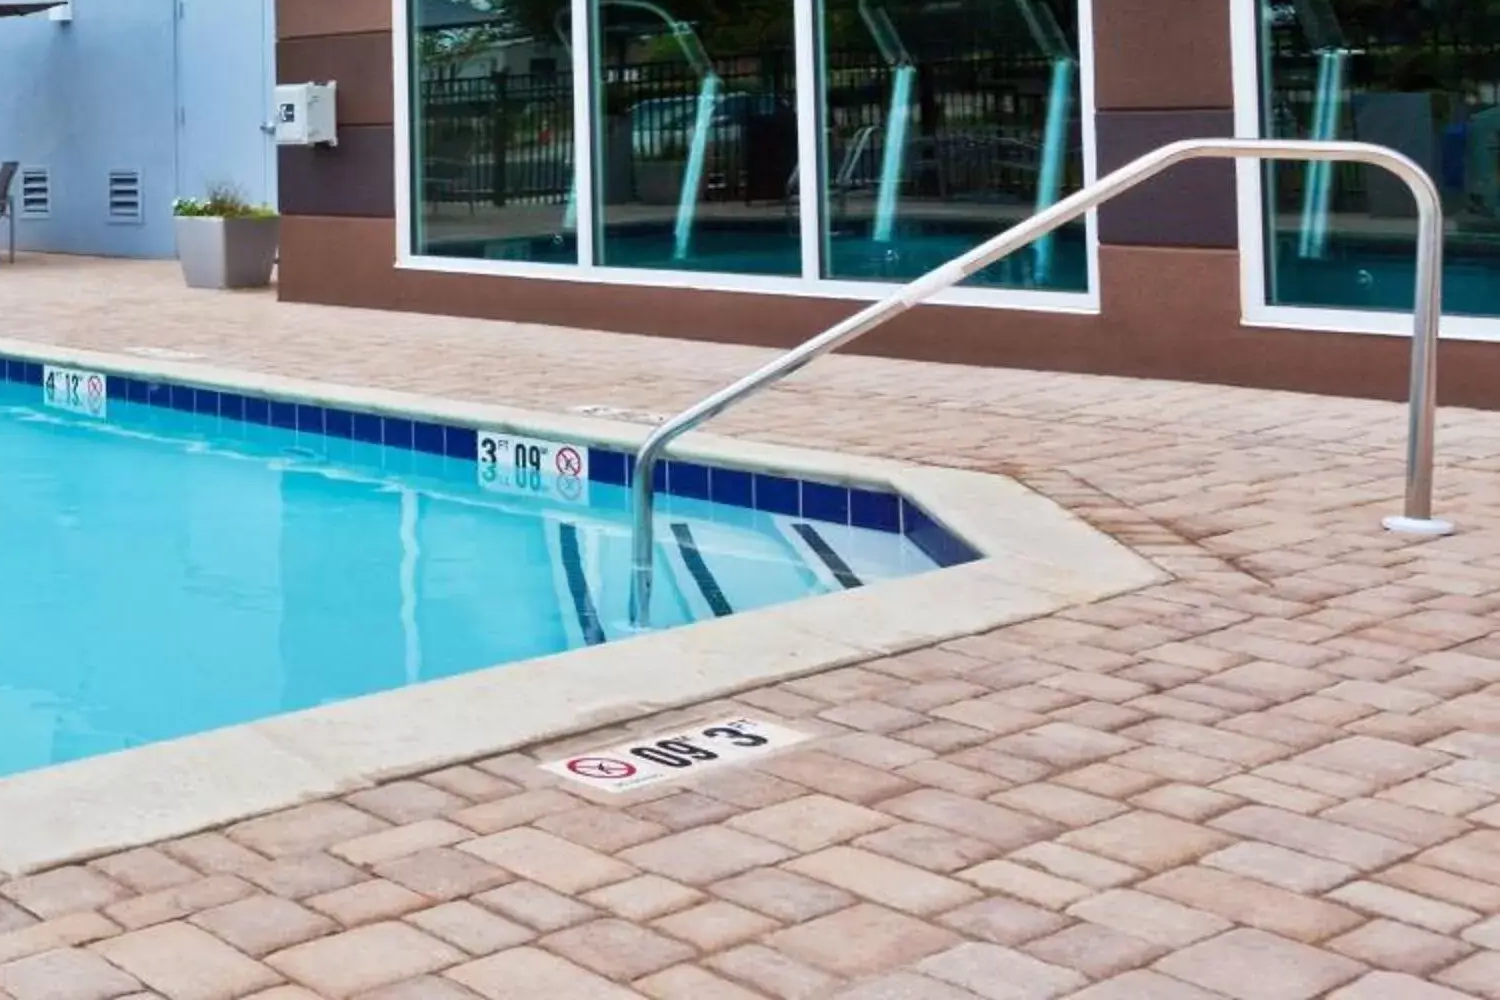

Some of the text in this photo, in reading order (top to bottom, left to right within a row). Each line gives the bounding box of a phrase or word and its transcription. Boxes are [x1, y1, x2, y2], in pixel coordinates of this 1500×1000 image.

[481, 437, 497, 470] 3
[629, 740, 719, 768] 09
[703, 727, 769, 747] 3
